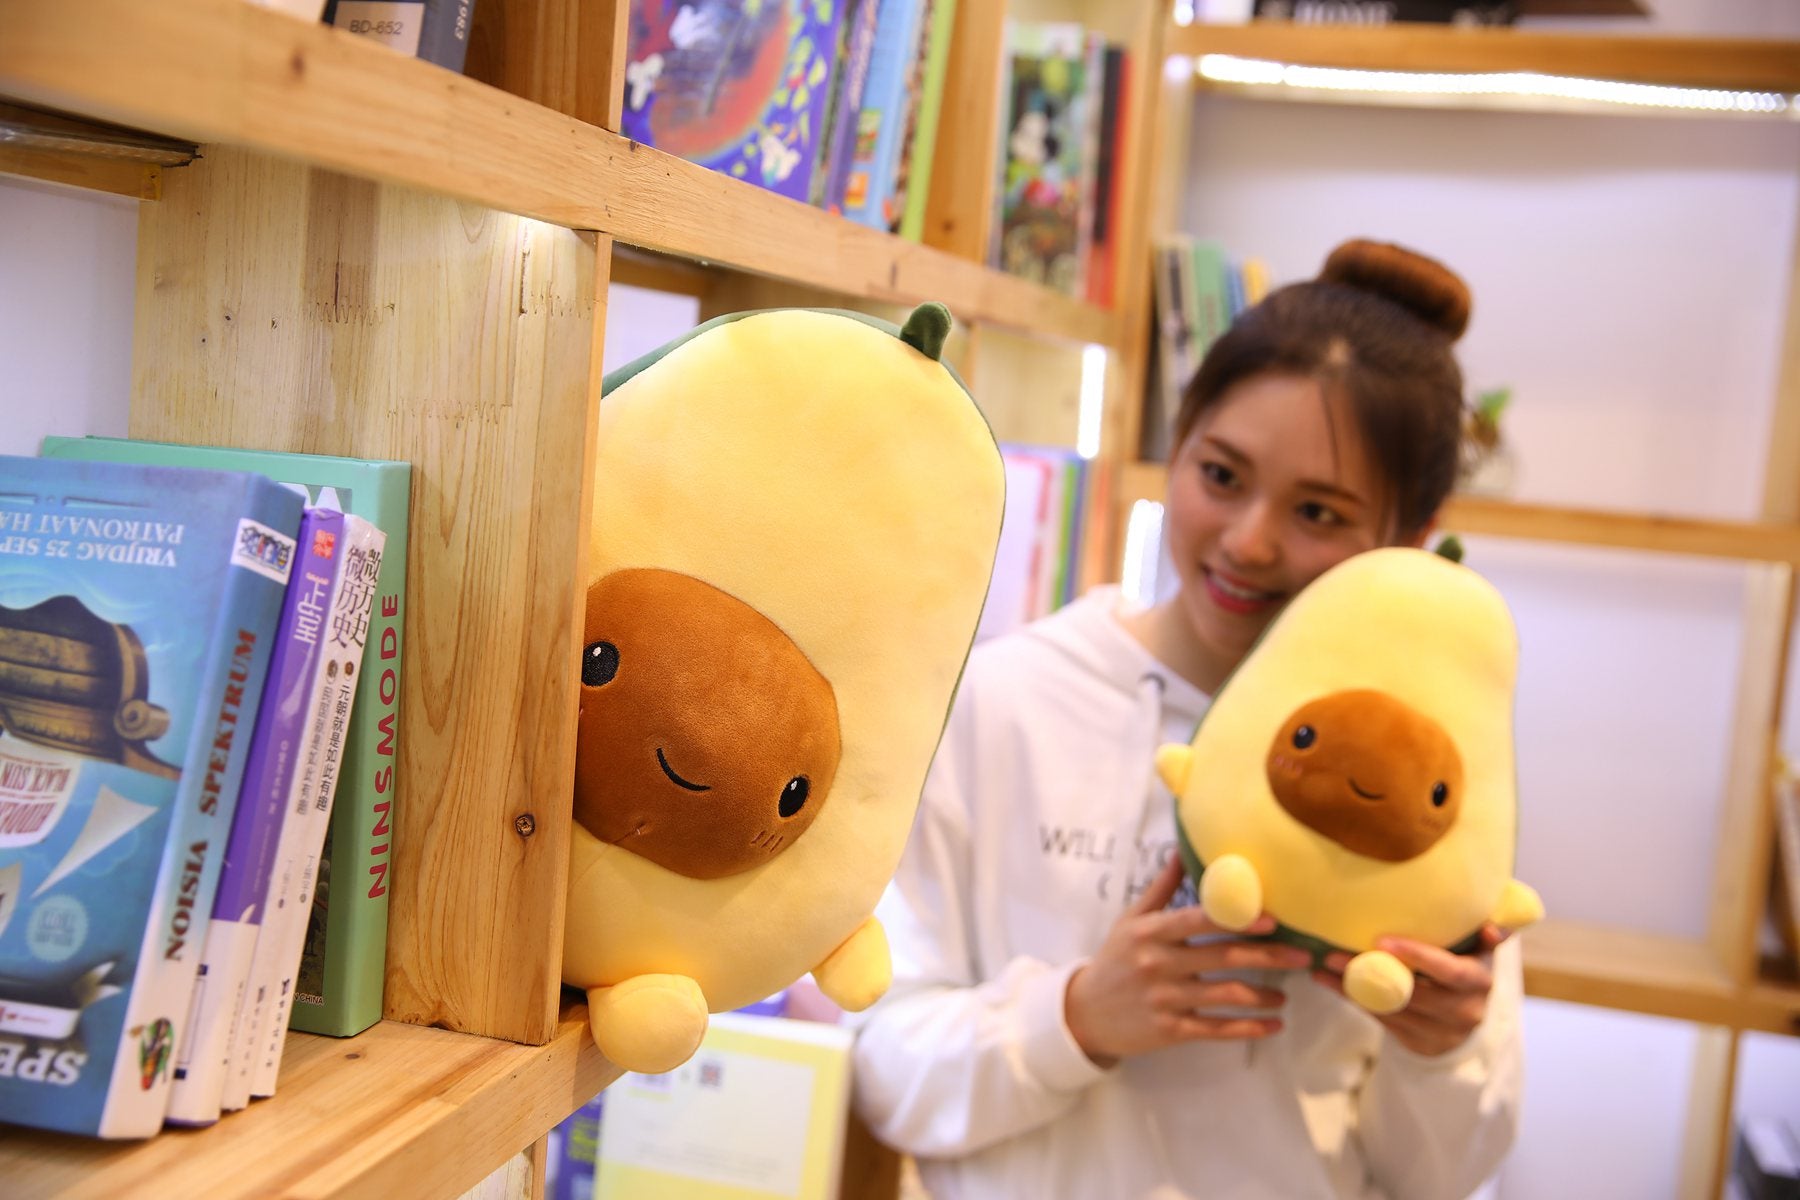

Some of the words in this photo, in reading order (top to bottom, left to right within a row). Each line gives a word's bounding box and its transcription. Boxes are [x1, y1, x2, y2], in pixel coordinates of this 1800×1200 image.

[349, 19, 404, 35] BD-652
[37, 514, 185, 544] PATRONAAT
[45, 539, 71, 558] 25
[76, 541, 177, 567] VRIJDAG
[331, 545, 366, 648] 微历史
[368, 594, 398, 899] NINSMODE
[164, 840, 209, 962] NOISIA
[198, 628, 257, 817] SPEKTRUM
[299, 993, 323, 1005] CHINA
